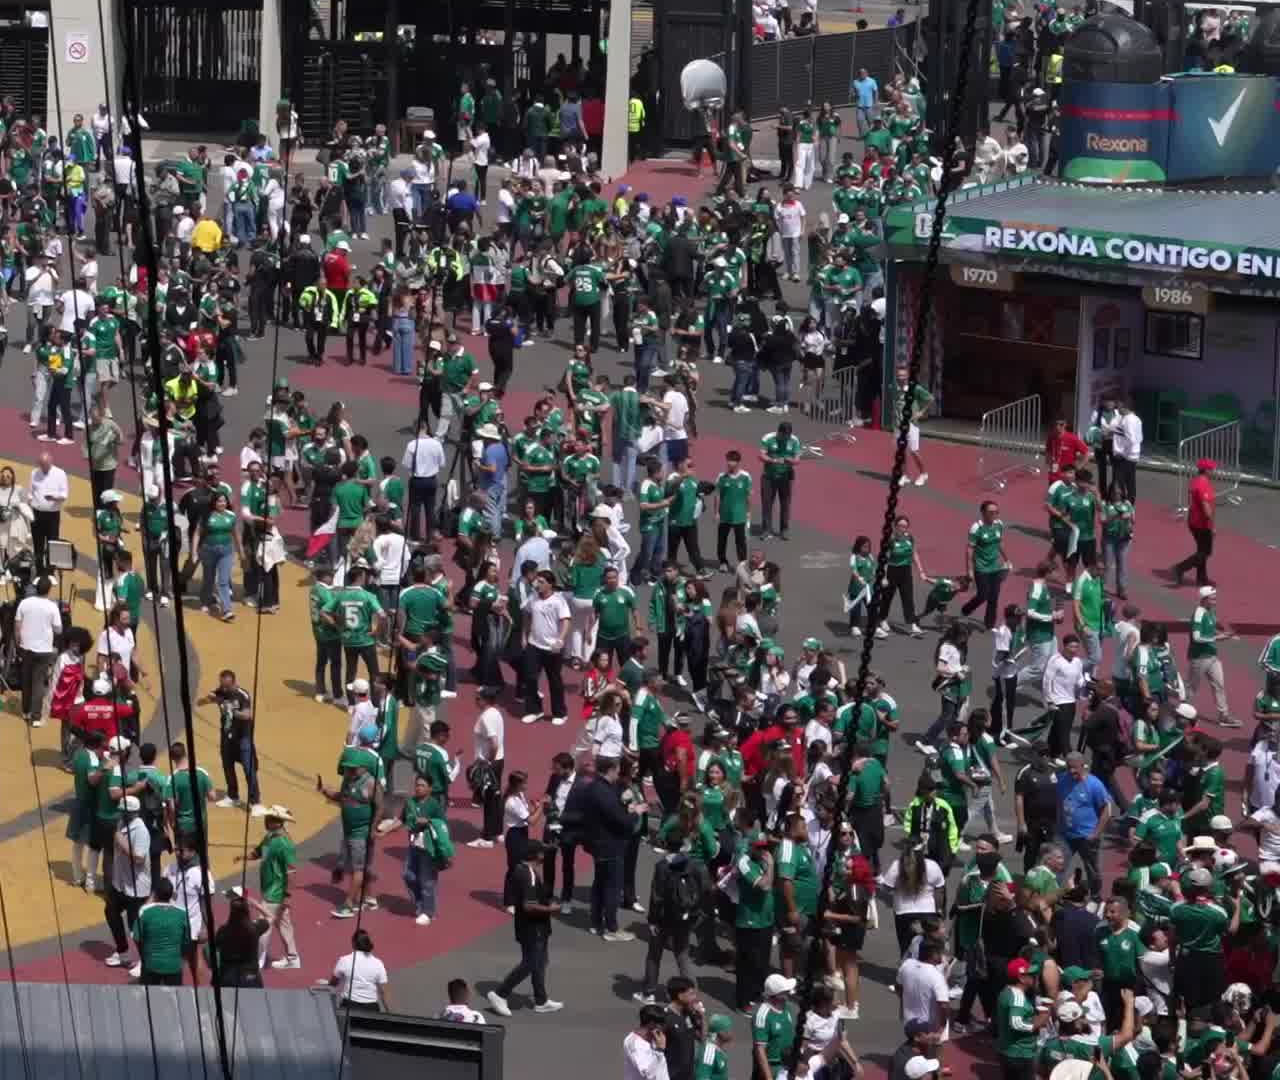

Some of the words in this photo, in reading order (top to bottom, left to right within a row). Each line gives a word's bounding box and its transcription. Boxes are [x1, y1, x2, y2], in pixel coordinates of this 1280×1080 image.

[1087, 133, 1147, 152] Rexona
[985, 226, 1099, 257] REXONA
[1104, 239, 1232, 271] CONTIGO
[963, 267, 999, 284] 1970
[1154, 287, 1193, 305] 1986
[345, 607, 358, 627] 5
